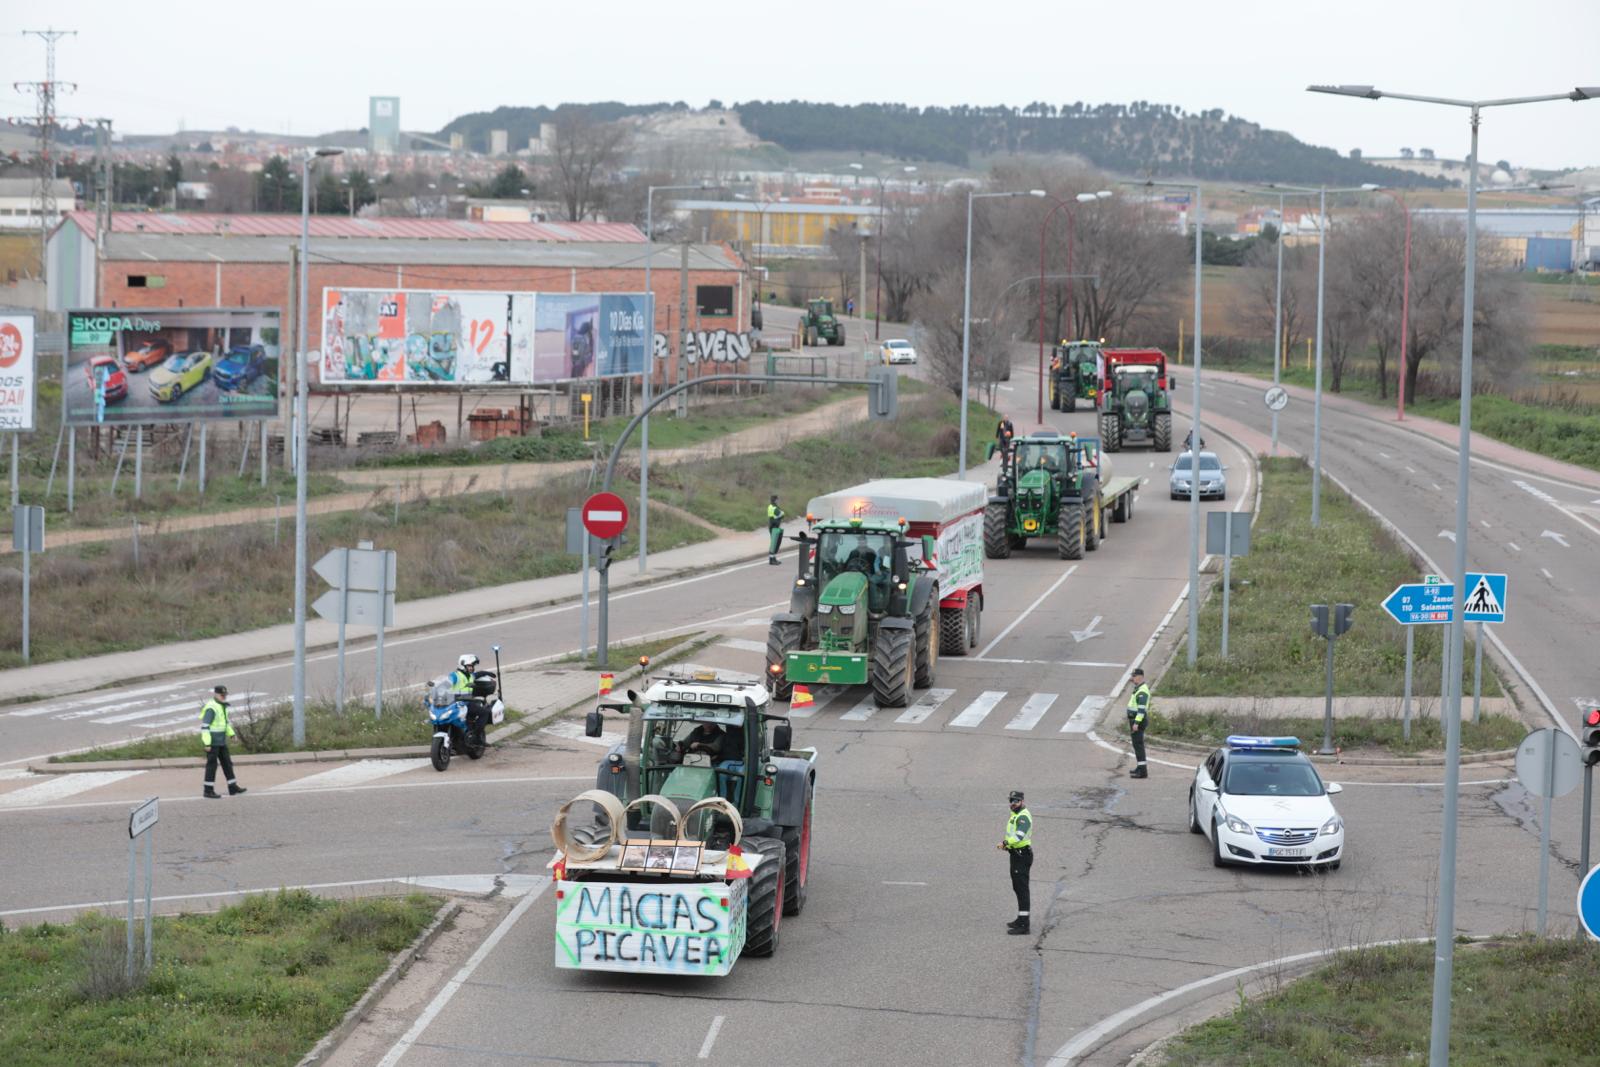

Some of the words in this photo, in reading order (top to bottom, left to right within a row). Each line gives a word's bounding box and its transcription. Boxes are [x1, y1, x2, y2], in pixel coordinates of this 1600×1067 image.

[135, 317, 161, 334] Days
[576, 886, 718, 933] MACIAS
[575, 929, 723, 965] PICAVEA
